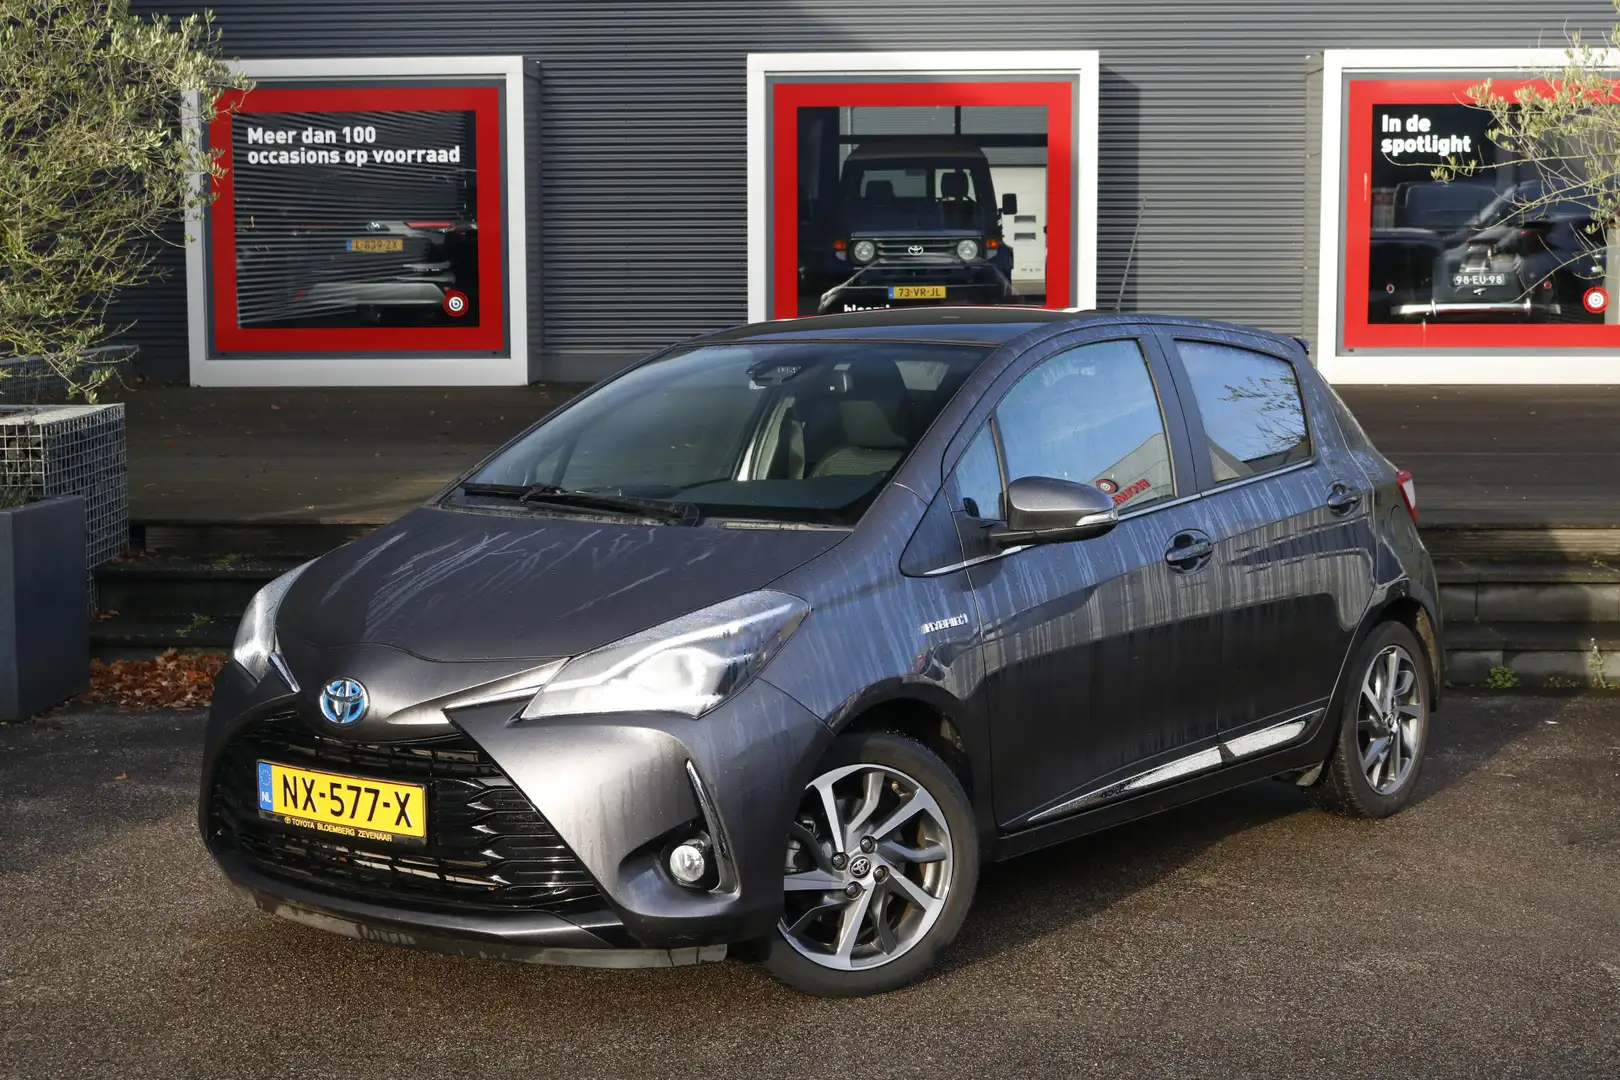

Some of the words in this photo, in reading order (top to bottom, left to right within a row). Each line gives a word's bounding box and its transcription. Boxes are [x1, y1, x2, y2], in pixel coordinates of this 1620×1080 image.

[1382, 114, 1401, 132] In
[1406, 114, 1431, 132] de
[247, 127, 297, 144] Meer
[302, 127, 337, 144] dan
[342, 126, 376, 143] 100
[1381, 134, 1471, 156] spotlight
[247, 147, 340, 164] occasions
[345, 149, 368, 167] op
[372, 145, 460, 163] voorraad
[898, 287, 941, 298] 73-VR-JL
[261, 791, 272, 803] NL
[282, 774, 412, 828] NX-577-X
[292, 818, 315, 830] TOYOTA
[317, 823, 356, 837] BLOEMBERG
[358, 830, 393, 842] ZEVENAAR
